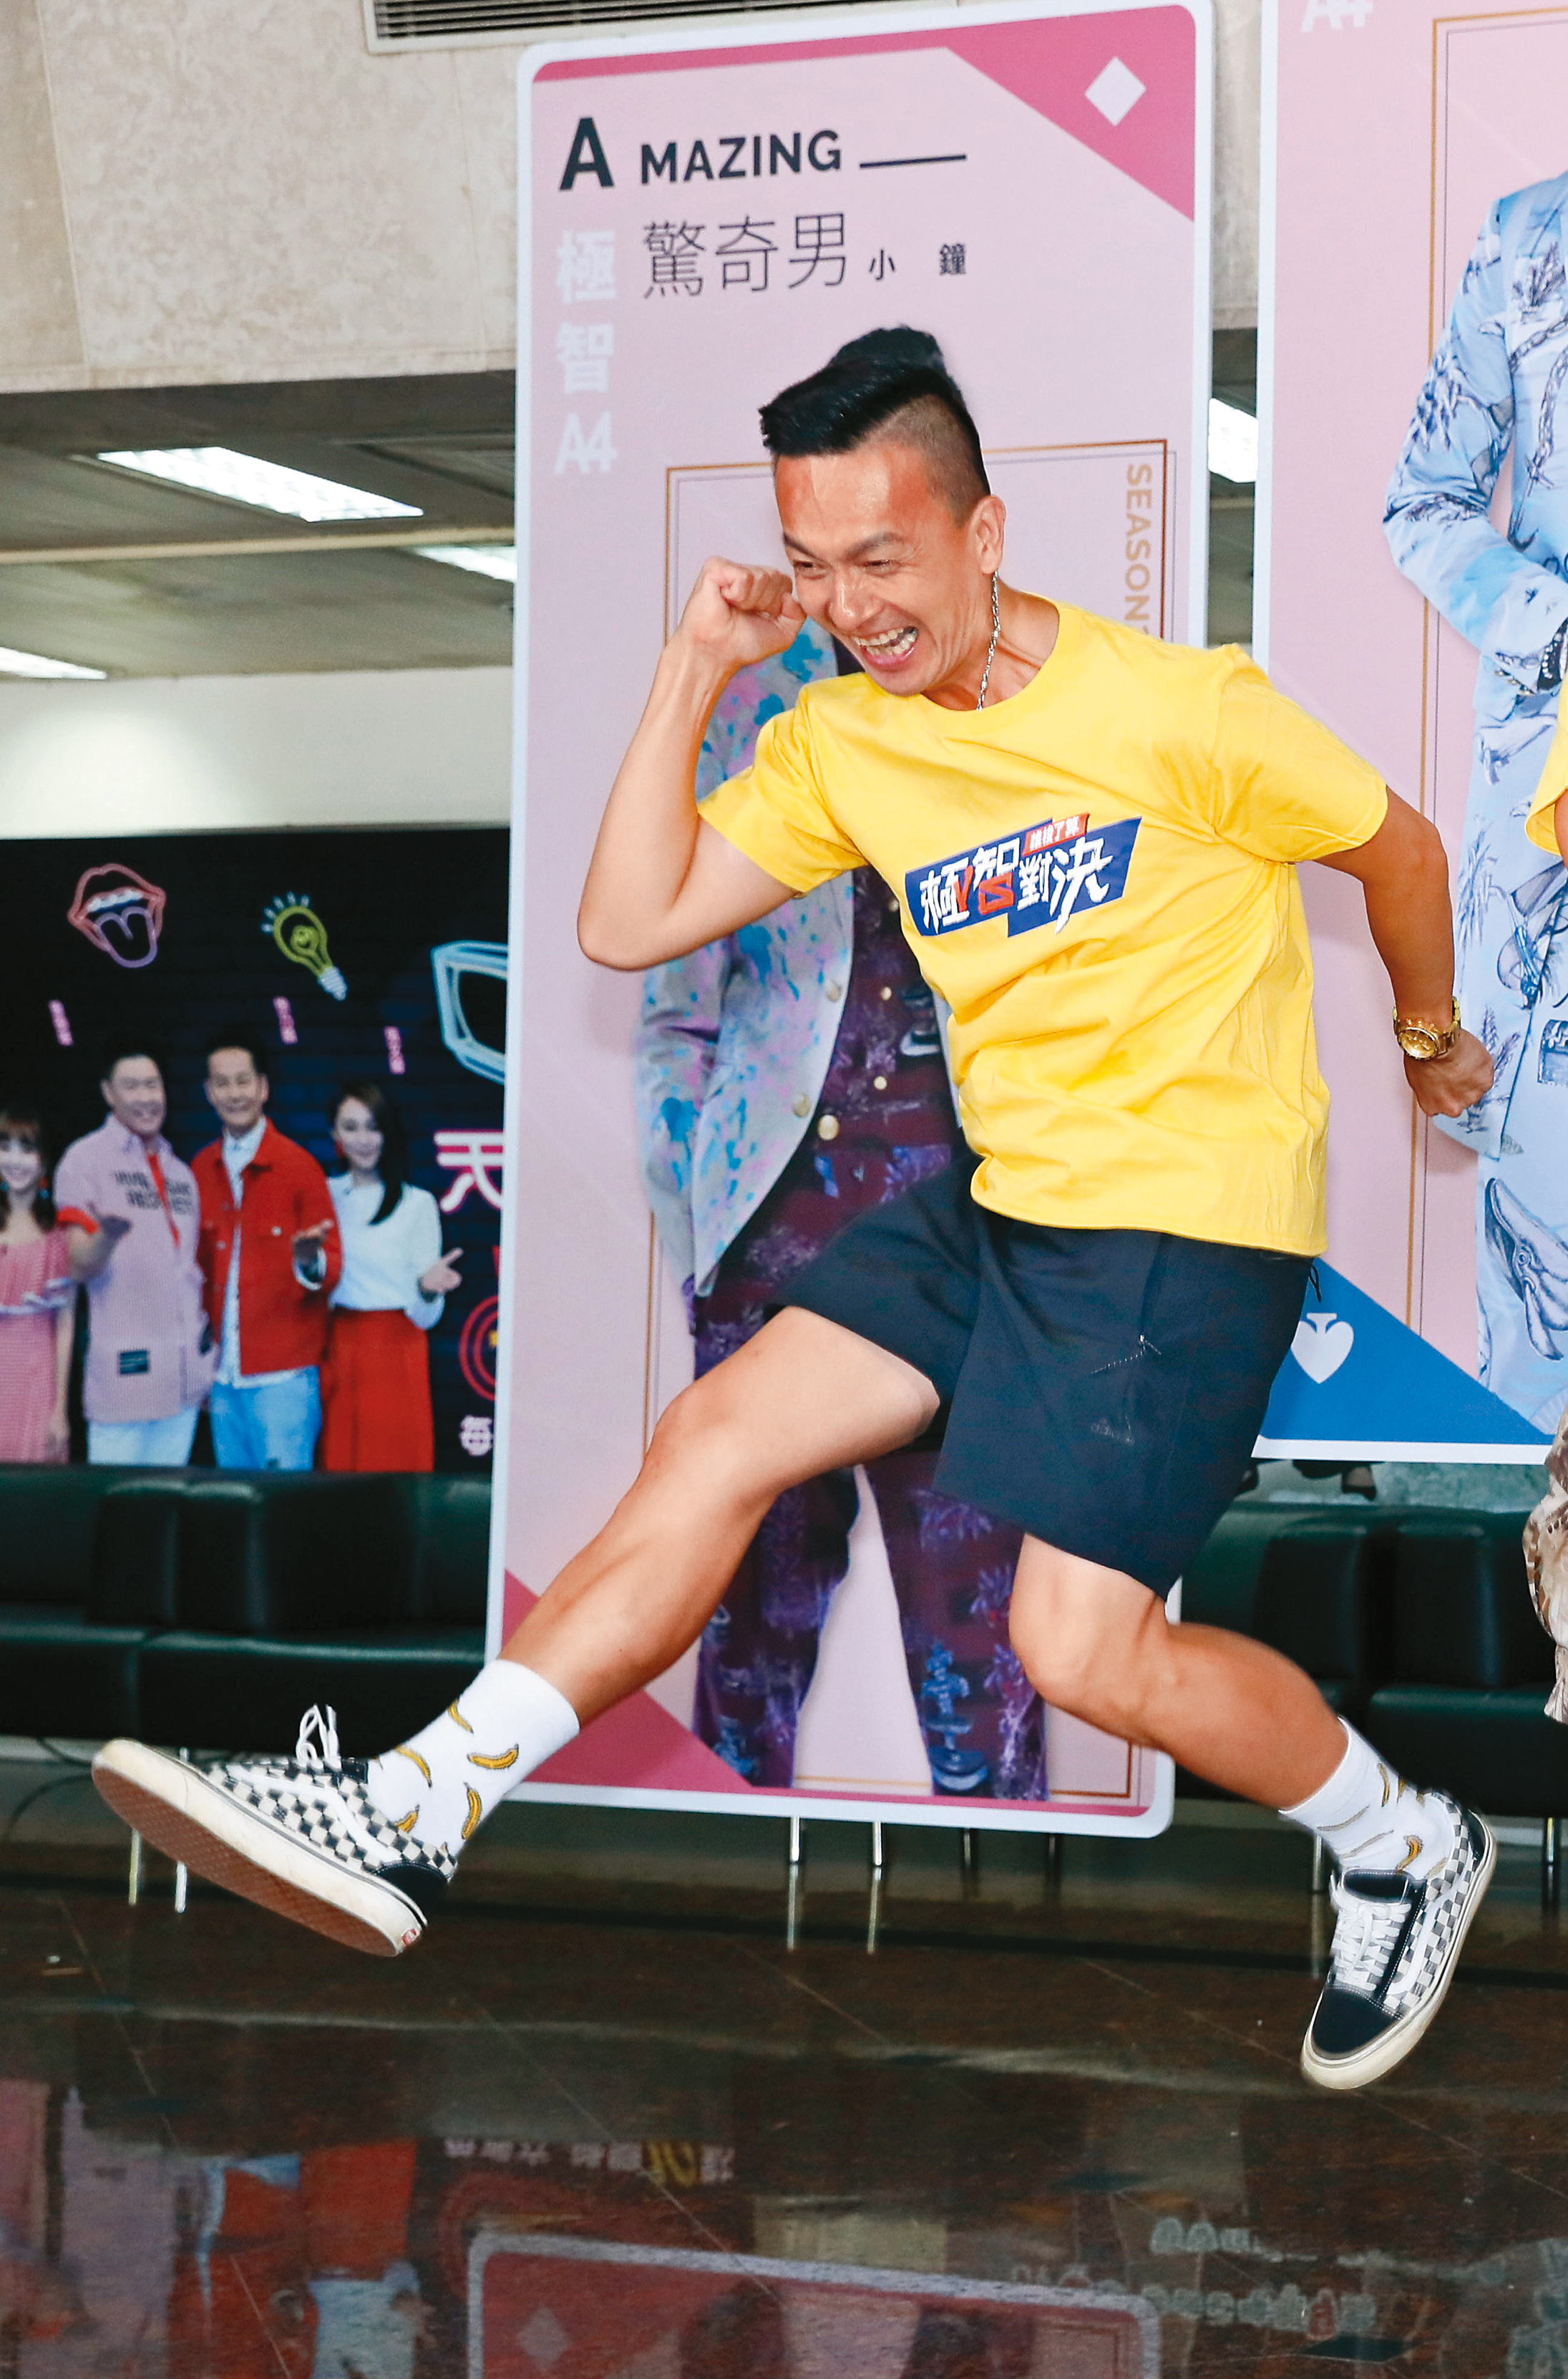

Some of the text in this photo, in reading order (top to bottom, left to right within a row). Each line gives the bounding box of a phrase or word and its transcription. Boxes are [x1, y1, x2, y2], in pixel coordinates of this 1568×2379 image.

[641, 130, 842, 184] MAZING
[643, 213, 847, 298] 驚奇男
[433, 1131, 503, 1212] 天
